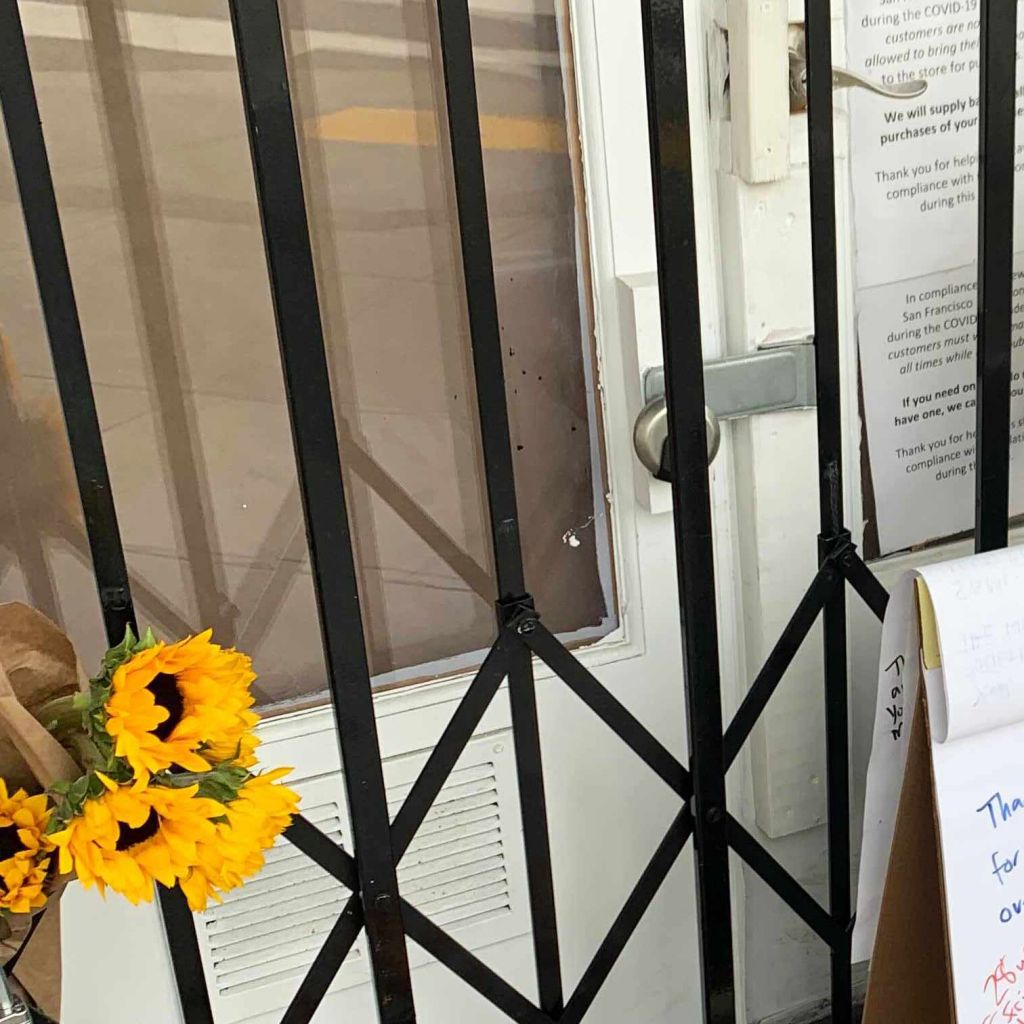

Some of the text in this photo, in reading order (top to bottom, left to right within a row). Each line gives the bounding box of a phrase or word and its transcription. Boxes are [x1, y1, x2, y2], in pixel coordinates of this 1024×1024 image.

[861, 14, 900, 29] during
[903, 8, 921, 22] the
[886, 26, 943, 45] customers
[946, 22, 964, 35] are
[865, 48, 910, 68] allowed
[913, 47, 925, 59] to
[928, 42, 957, 59] bring
[881, 73, 894, 86] to
[897, 69, 915, 83] the
[918, 66, 948, 79] store
[950, 60, 966, 73] for
[884, 110, 904, 124] We
[907, 105, 927, 120] will
[929, 99, 967, 118] supply
[880, 116, 978, 146] purchases of your
[875, 169, 909, 183] Thank
[912, 164, 932, 177] you
[934, 157, 950, 171] for
[886, 174, 975, 200] compliance with
[920, 191, 976, 213] during this
[906, 281, 978, 304] In compliance
[903, 300, 973, 324] San Francisco
[887, 323, 942, 343] during the
[888, 341, 942, 361] customers
[944, 335, 970, 348] must
[900, 351, 973, 375] all times while
[902, 397, 912, 409] If
[912, 393, 933, 407] you
[934, 385, 960, 401] need
[895, 413, 920, 427] have
[922, 408, 945, 421] one,
[947, 403, 963, 413] we
[896, 443, 926, 459] Thank
[929, 438, 948, 452] you
[949, 431, 963, 444] for
[906, 451, 962, 474] compliance
[935, 465, 968, 482] during
[991, 850, 1021, 885] for
